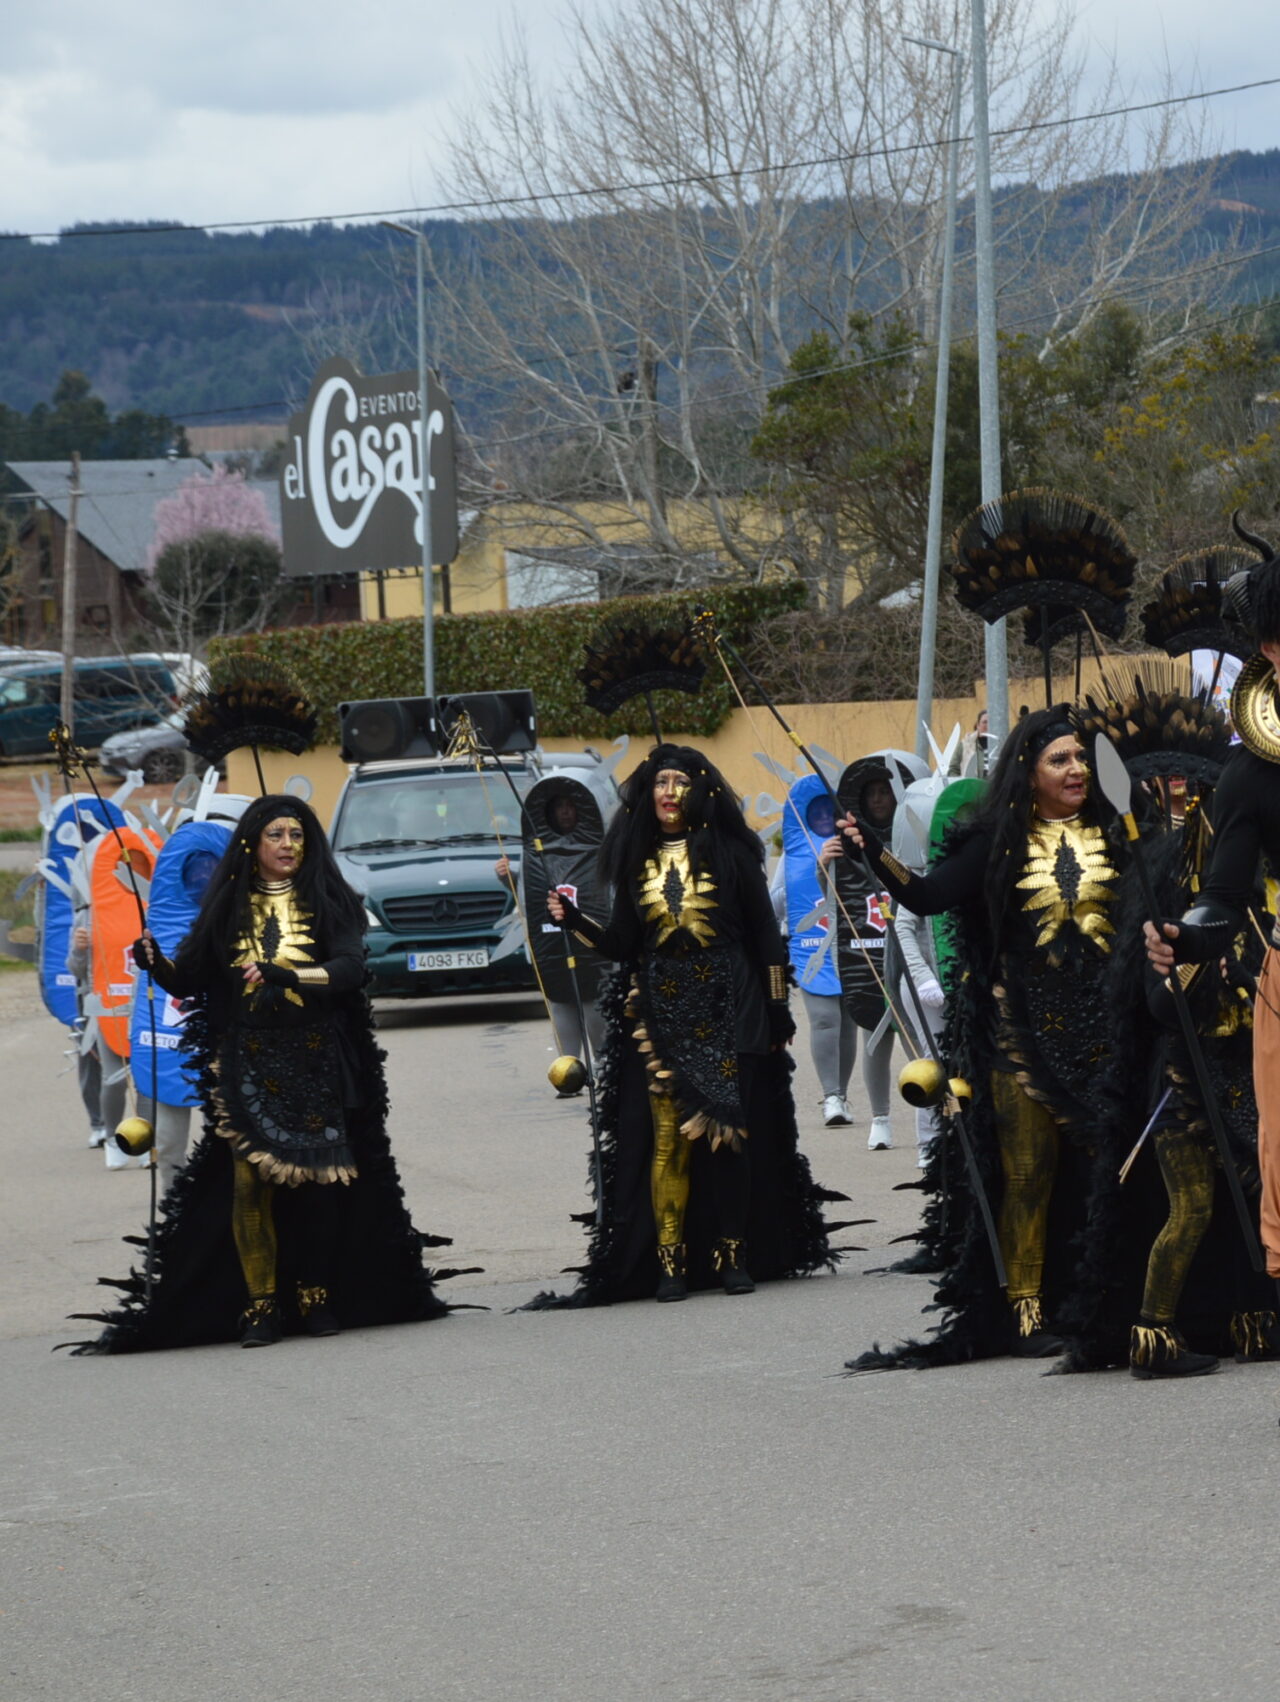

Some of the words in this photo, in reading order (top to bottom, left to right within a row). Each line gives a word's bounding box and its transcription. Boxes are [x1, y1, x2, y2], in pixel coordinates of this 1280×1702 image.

[284, 435, 306, 500] el
[308, 376, 444, 549] Casar
[419, 953, 453, 968] 4093
[457, 951, 484, 966] FKG
